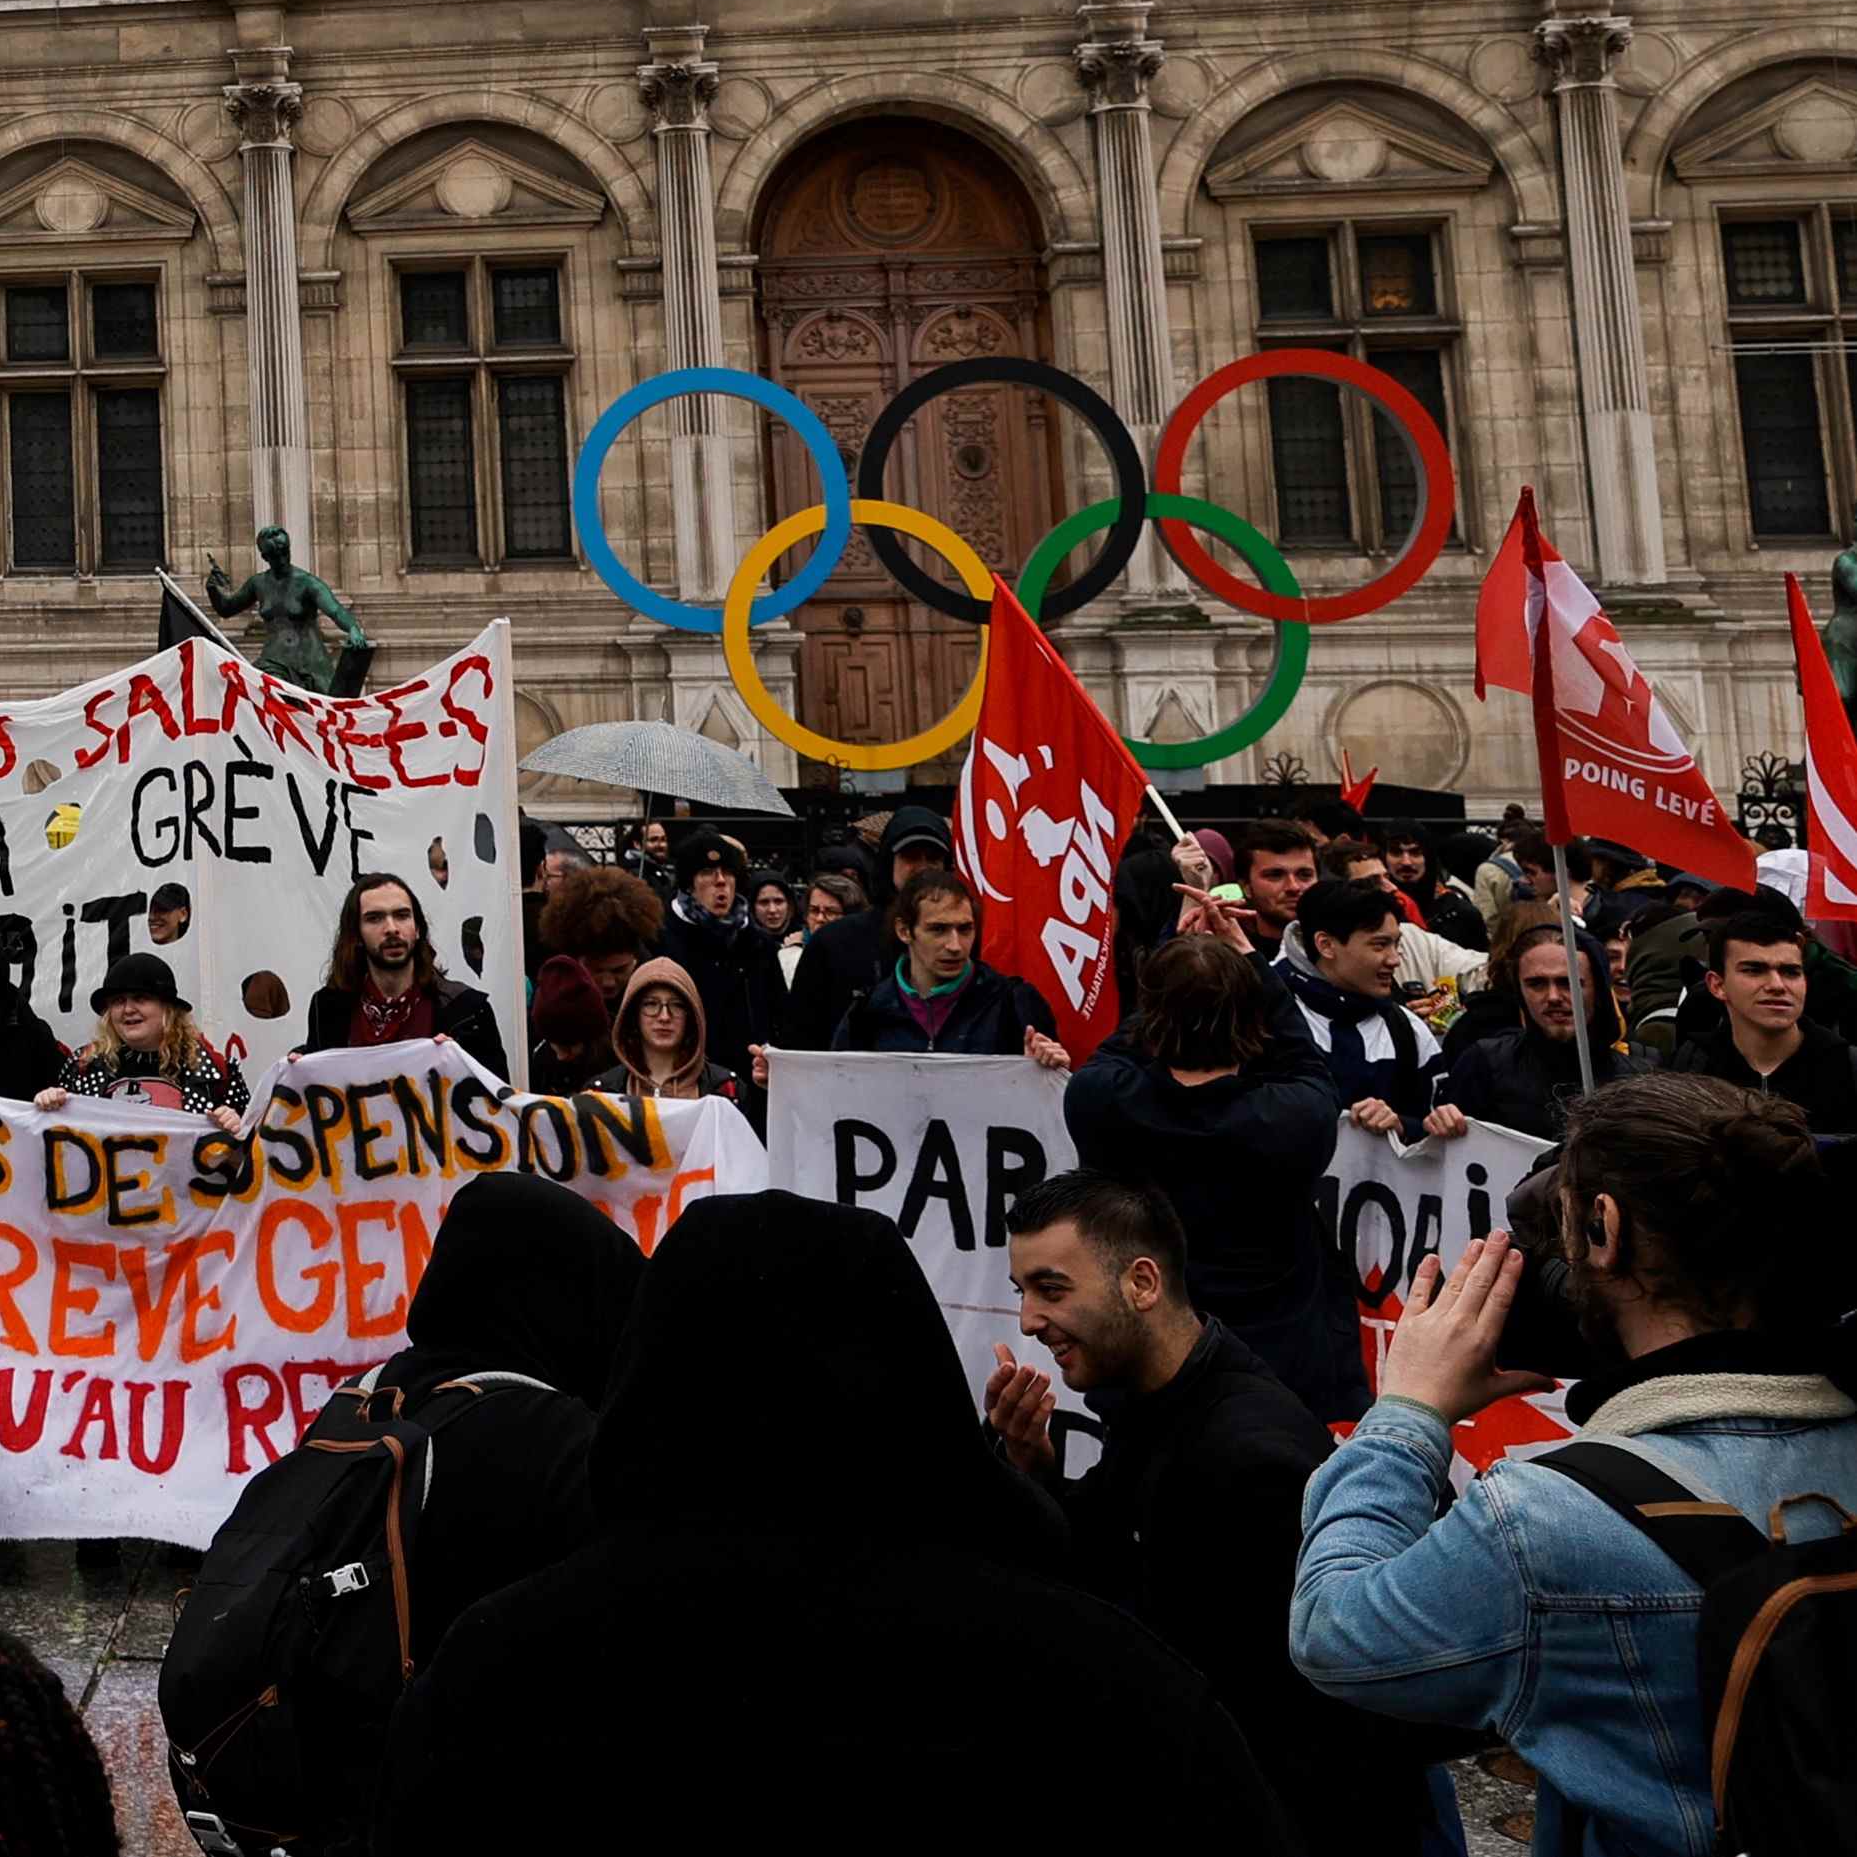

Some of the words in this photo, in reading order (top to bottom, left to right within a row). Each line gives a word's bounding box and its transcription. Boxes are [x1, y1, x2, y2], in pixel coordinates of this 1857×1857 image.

[130, 735, 380, 884] GRÈVE
[1563, 757, 1647, 802] POING
[1654, 784, 1715, 828] LEVÉ
[44, 1124, 179, 1228] DE
